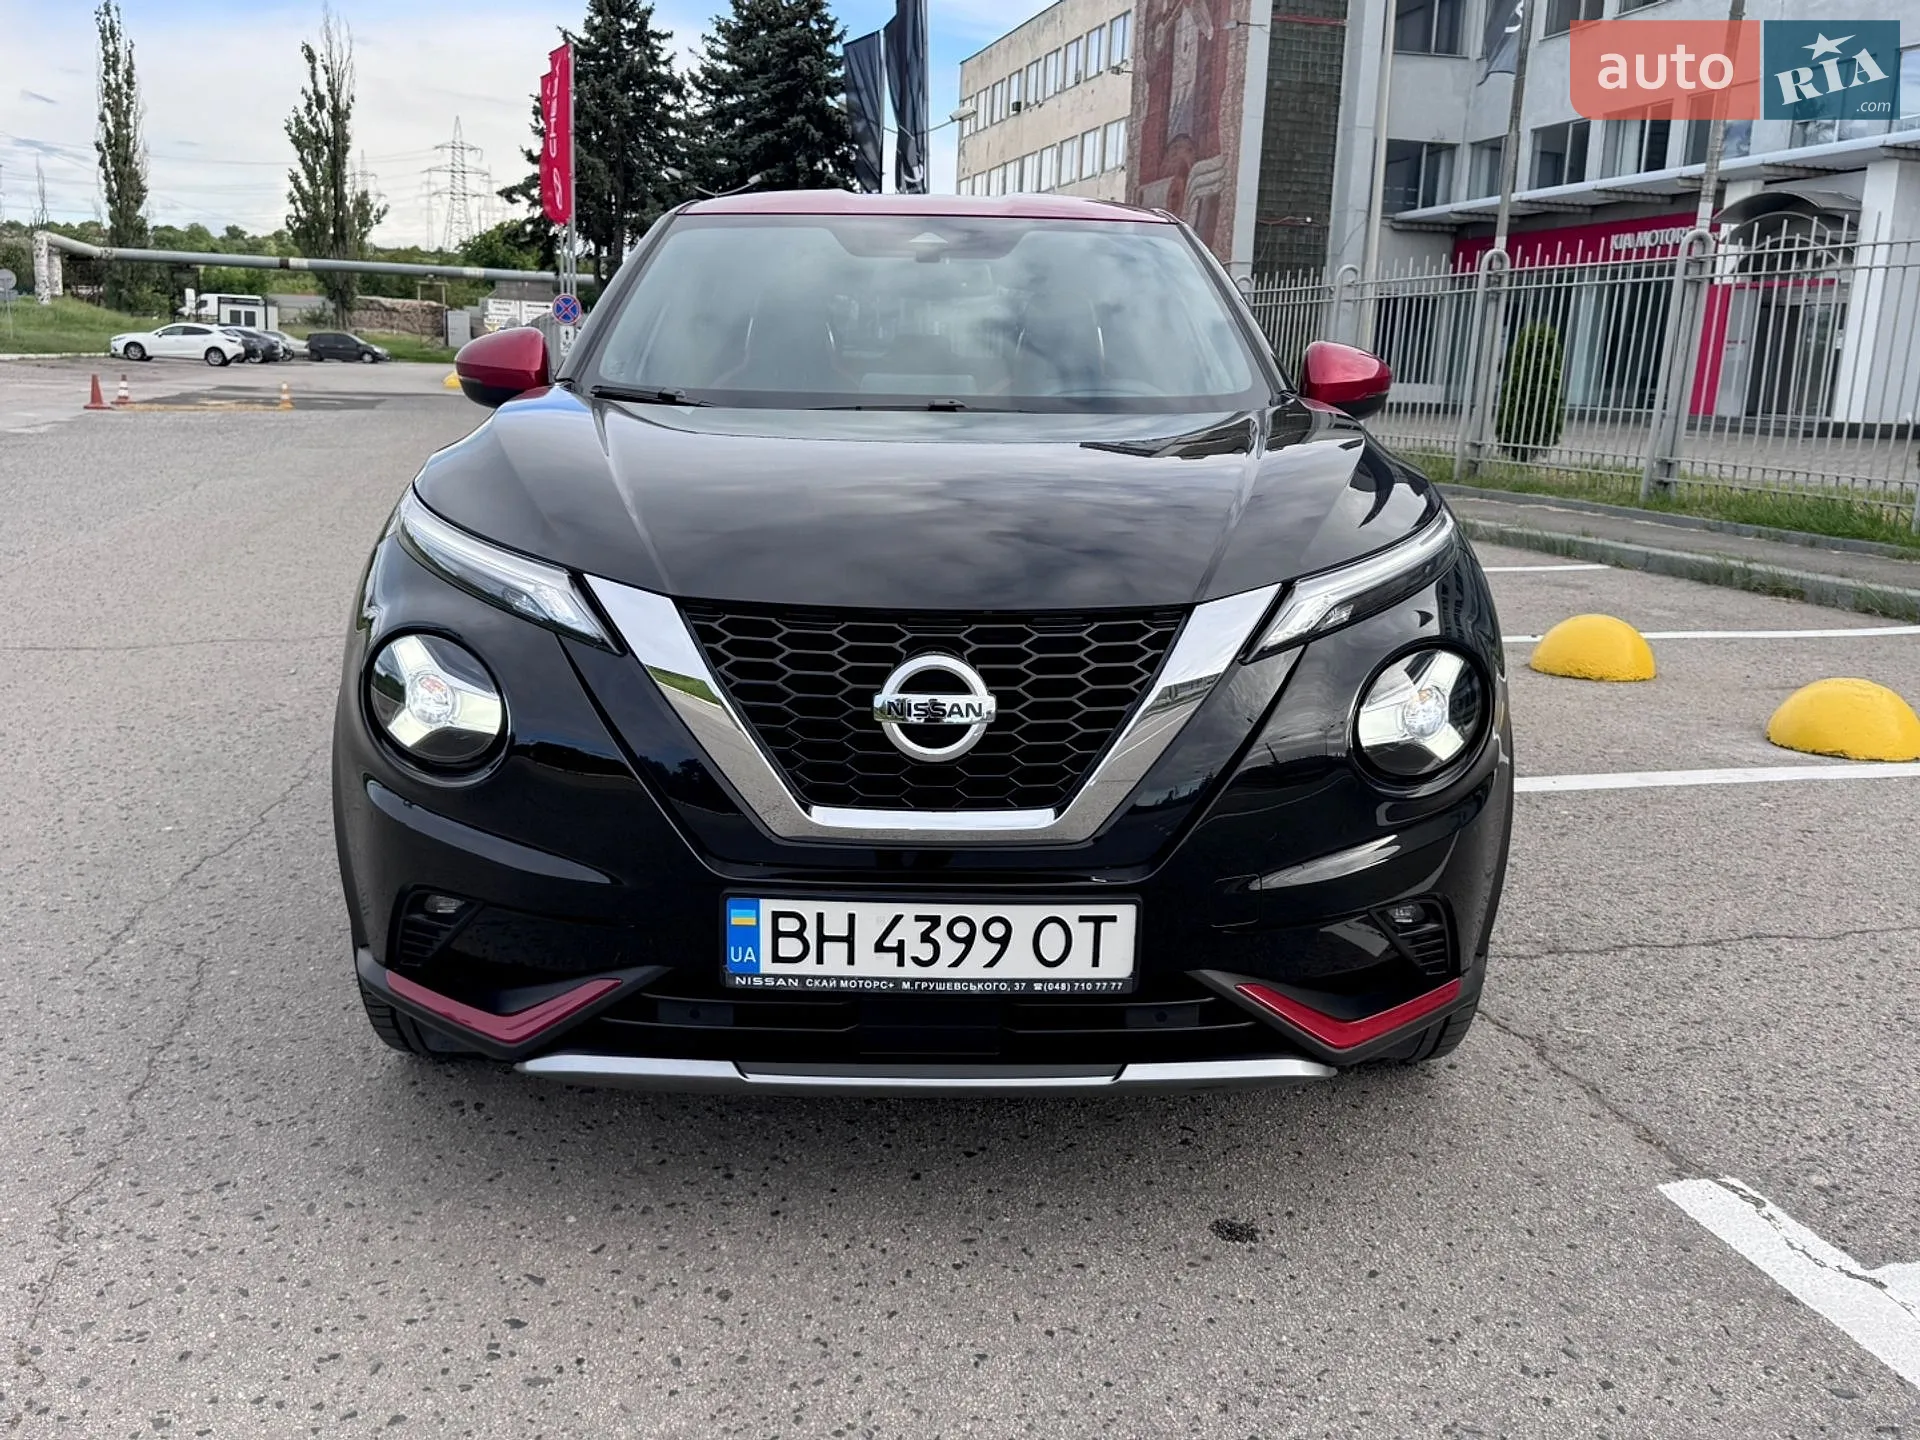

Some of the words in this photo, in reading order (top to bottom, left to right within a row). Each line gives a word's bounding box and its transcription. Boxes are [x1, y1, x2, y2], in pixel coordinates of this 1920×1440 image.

[1610, 232, 1635, 250] KIA
[1636, 225, 1695, 247] MOTOR
[886, 701, 983, 718] NISSAN
[771, 910, 856, 966] BH
[874, 914, 1013, 968] 4399
[1032, 915, 1118, 968] OT
[730, 946, 756, 962] UA
[735, 976, 799, 987] NISSAN
[805, 977, 837, 988] СКАЙ
[1014, 982, 1026, 991] 37
